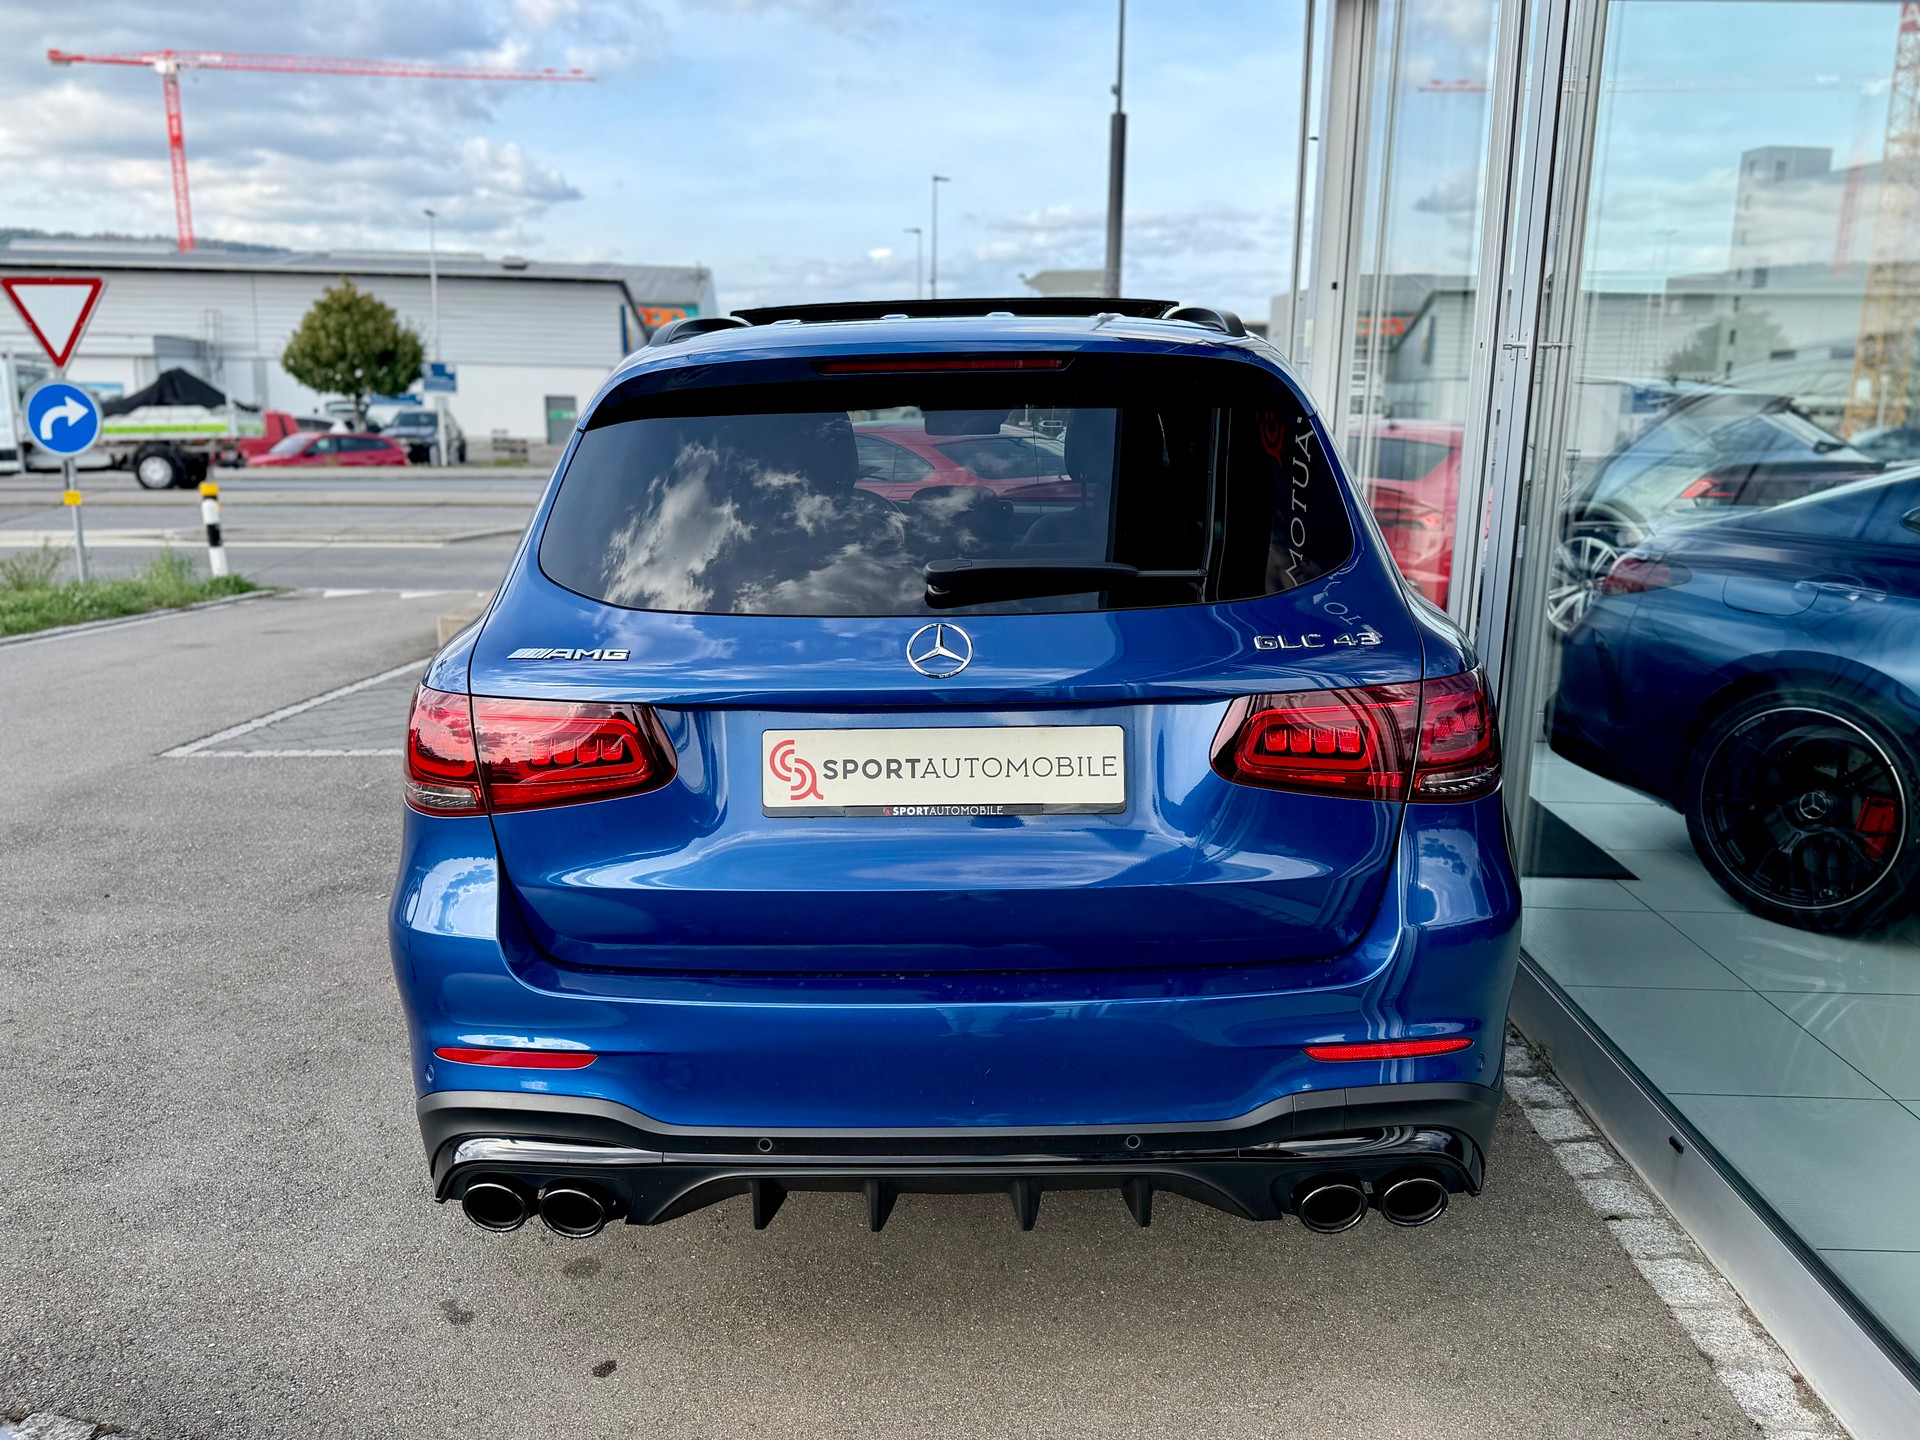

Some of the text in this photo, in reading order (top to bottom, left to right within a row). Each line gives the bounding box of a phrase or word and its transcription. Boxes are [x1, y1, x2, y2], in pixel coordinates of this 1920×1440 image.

[1253, 631, 1384, 651] GLC 43
[543, 648, 630, 661] AMG
[822, 755, 1118, 780] SPORTAUTOMOBILE
[892, 805, 1004, 817] SPORTAUTOMOBILE
